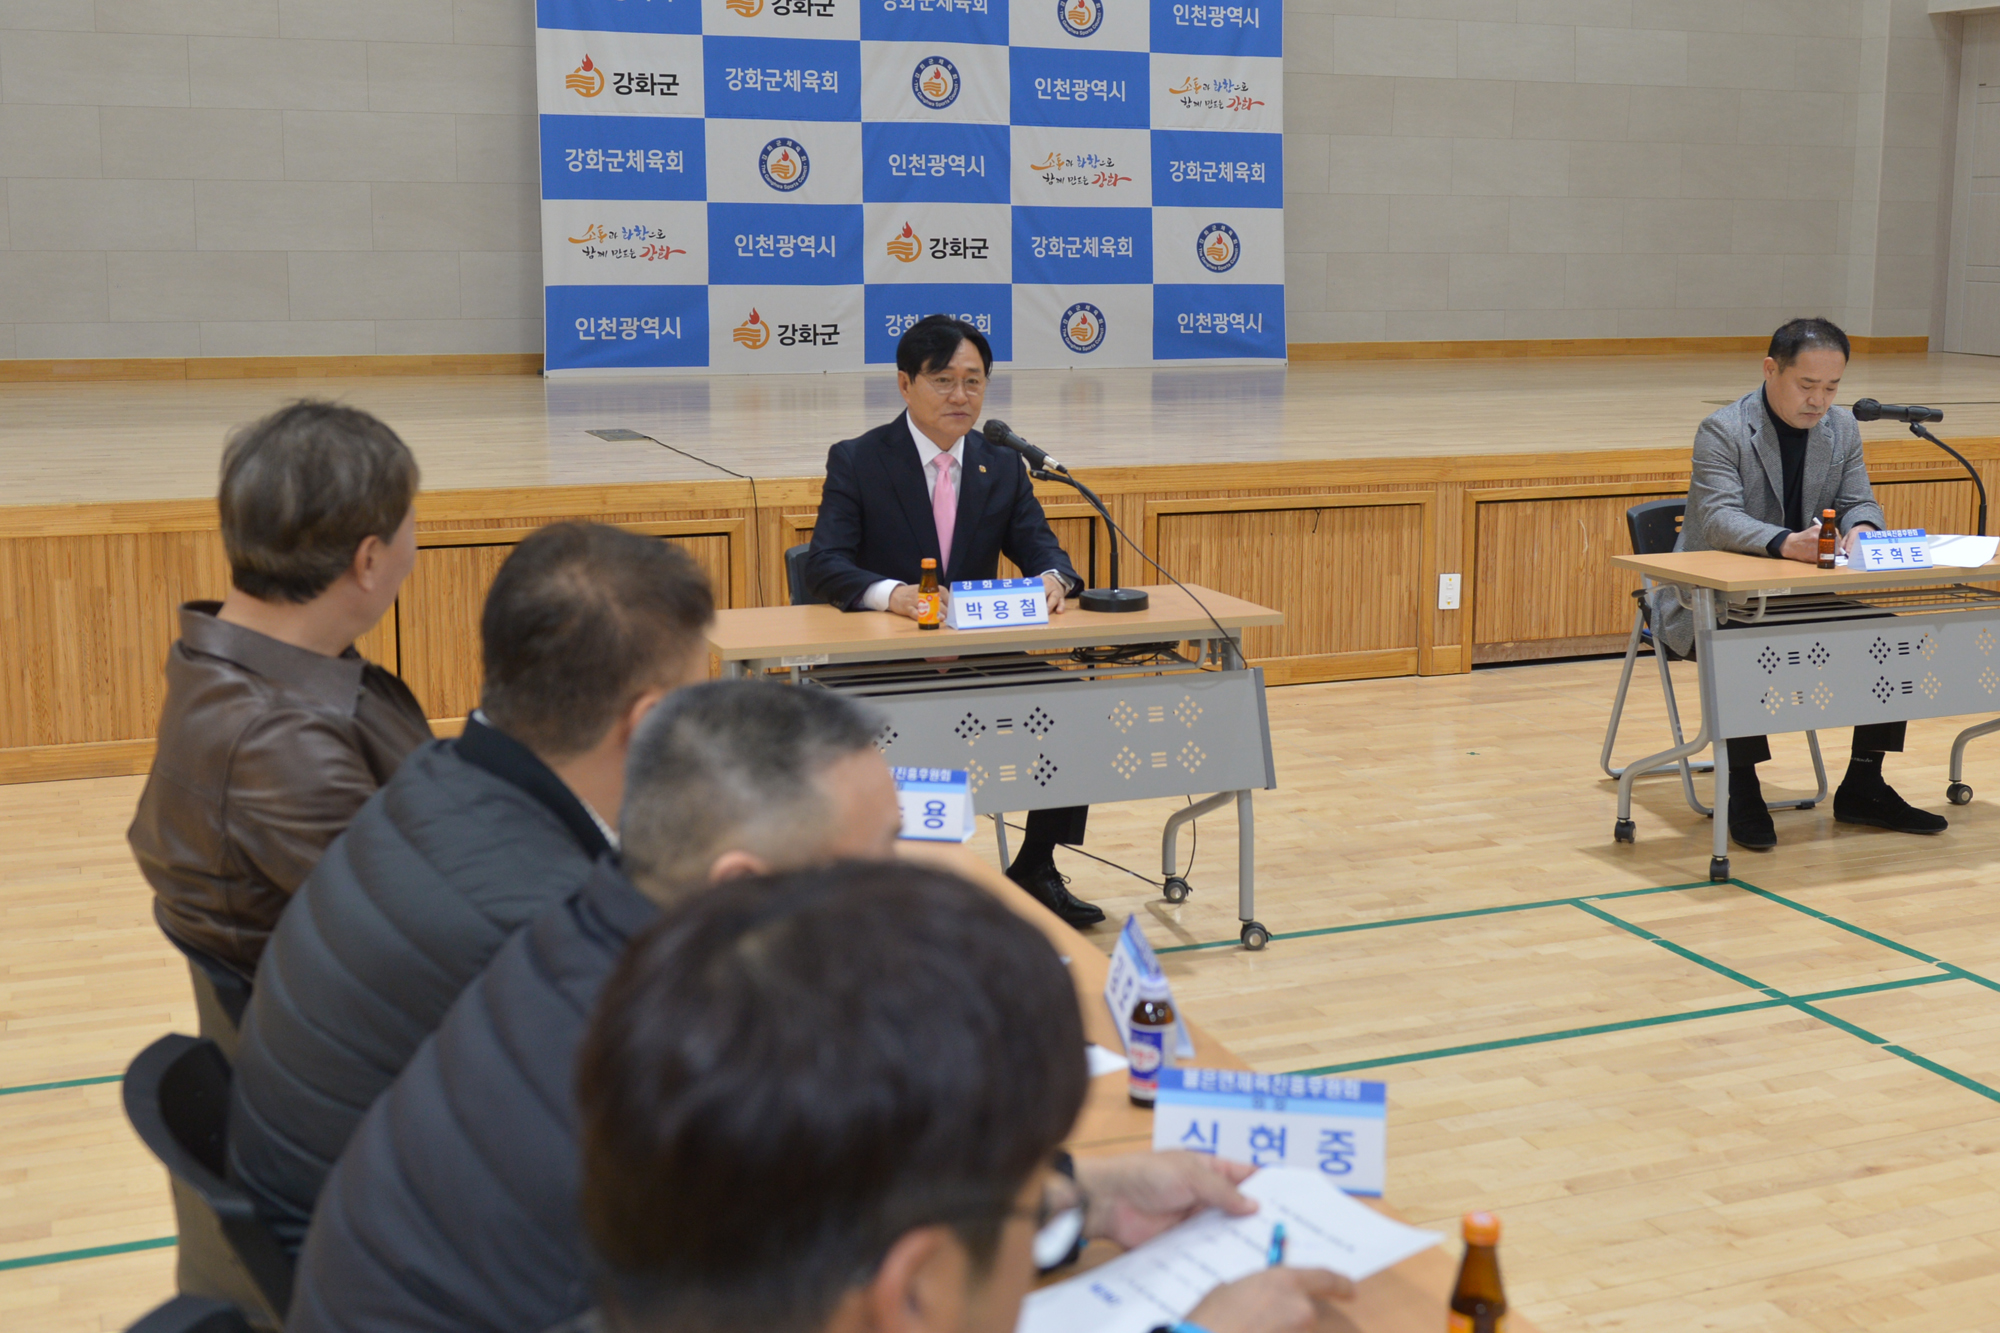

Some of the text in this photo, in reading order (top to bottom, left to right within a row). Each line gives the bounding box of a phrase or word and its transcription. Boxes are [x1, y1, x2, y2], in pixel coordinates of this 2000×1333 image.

[1173, 4, 1259, 29] 인천광역시
[612, 72, 680, 96] 강화군
[725, 67, 838, 94] 강화군체육회
[1034, 77, 1126, 102] 인천광역시
[1169, 76, 1210, 94] 소통과
[1226, 95, 1265, 112] 강화
[565, 148, 683, 173] 강화군체육회
[888, 153, 985, 177] 인천광역시
[1030, 152, 1073, 171] 소통과
[1169, 160, 1265, 184] 강화군체육회
[1091, 171, 1132, 188] 강화
[568, 223, 618, 244] 소통과
[639, 243, 687, 261] 강화
[734, 234, 836, 258] 인천광역시
[929, 237, 989, 260] 강화군
[1031, 236, 1133, 259] 강화군체육회
[575, 316, 681, 340] 인천광역시
[1177, 312, 1262, 334] 인천광역시
[777, 323, 841, 347] 강화군
[1871, 546, 1924, 565] 주혁돈
[961, 577, 1034, 591] 강화군수
[966, 598, 1037, 621] 박용철
